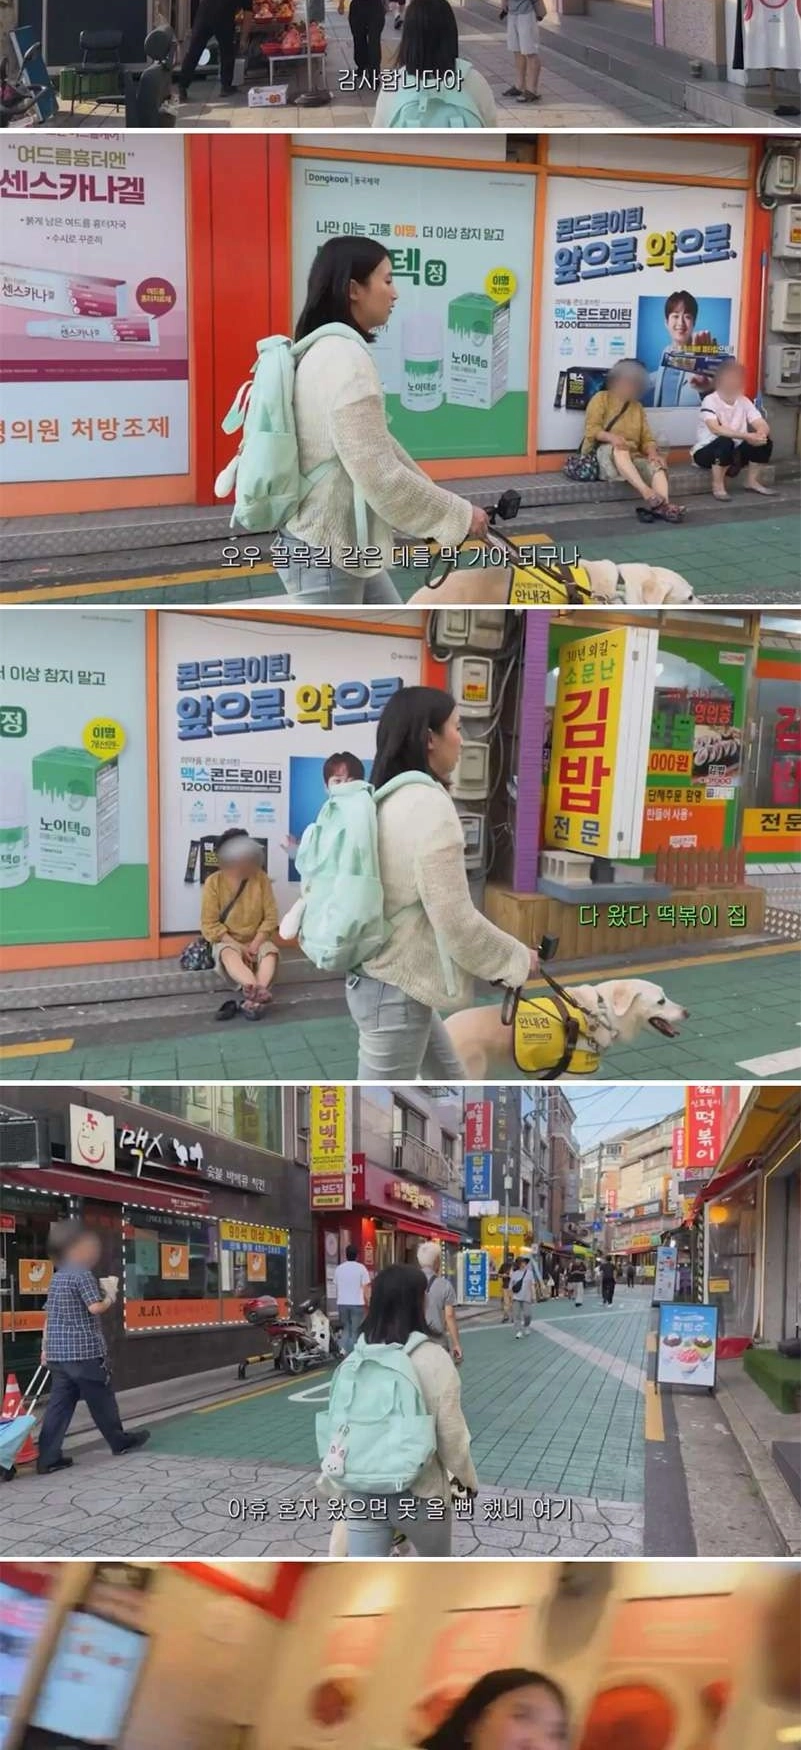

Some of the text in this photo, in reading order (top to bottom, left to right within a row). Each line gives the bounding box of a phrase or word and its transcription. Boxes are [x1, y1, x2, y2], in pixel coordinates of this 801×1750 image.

[0, 169, 145, 205] 센스카나겔
[308, 173, 349, 185] Dongkook
[354, 177, 380, 186] 동국제약
[26, 216, 43, 226] 붉게
[45, 216, 63, 226] 남은
[65, 217, 91, 228] 여드름
[52, 234, 103, 244] 수시로 꾸준히
[316, 220, 340, 235] 나만
[342, 222, 367, 236] 아는
[368, 223, 391, 237] 고통
[422, 226, 434, 238] 더
[436, 226, 457, 240] 이상
[460, 227, 481, 240] 참지
[483, 228, 505, 242] 말고
[554, 222, 737, 285] 앞으로. 약으로.
[493, 276, 510, 286] 이명
[554, 308, 632, 321] 맥스콘드로이틴
[555, 321, 577, 329] 1200
[71, 416, 170, 441] 처방조제
[515, 590, 551, 603] 안내견
[566, 646, 586, 663] 30년
[10, 667, 106, 686] 이상 참지 말고
[564, 658, 616, 686] 소문난
[176, 688, 294, 740] 앞으로.
[92, 727, 116, 739] 이명
[559, 687, 610, 814] 김밥
[181, 767, 281, 784] 맥스콘드로이틴
[182, 783, 212, 792] 1200
[40, 817, 80, 836] 노이텍
[554, 816, 601, 846] 전문
[760, 813, 801, 833] 전문
[518, 1016, 551, 1030] 안내견
[696, 1110, 716, 1162] 떡볶이
[227, 1169, 248, 1187] 바베큐
